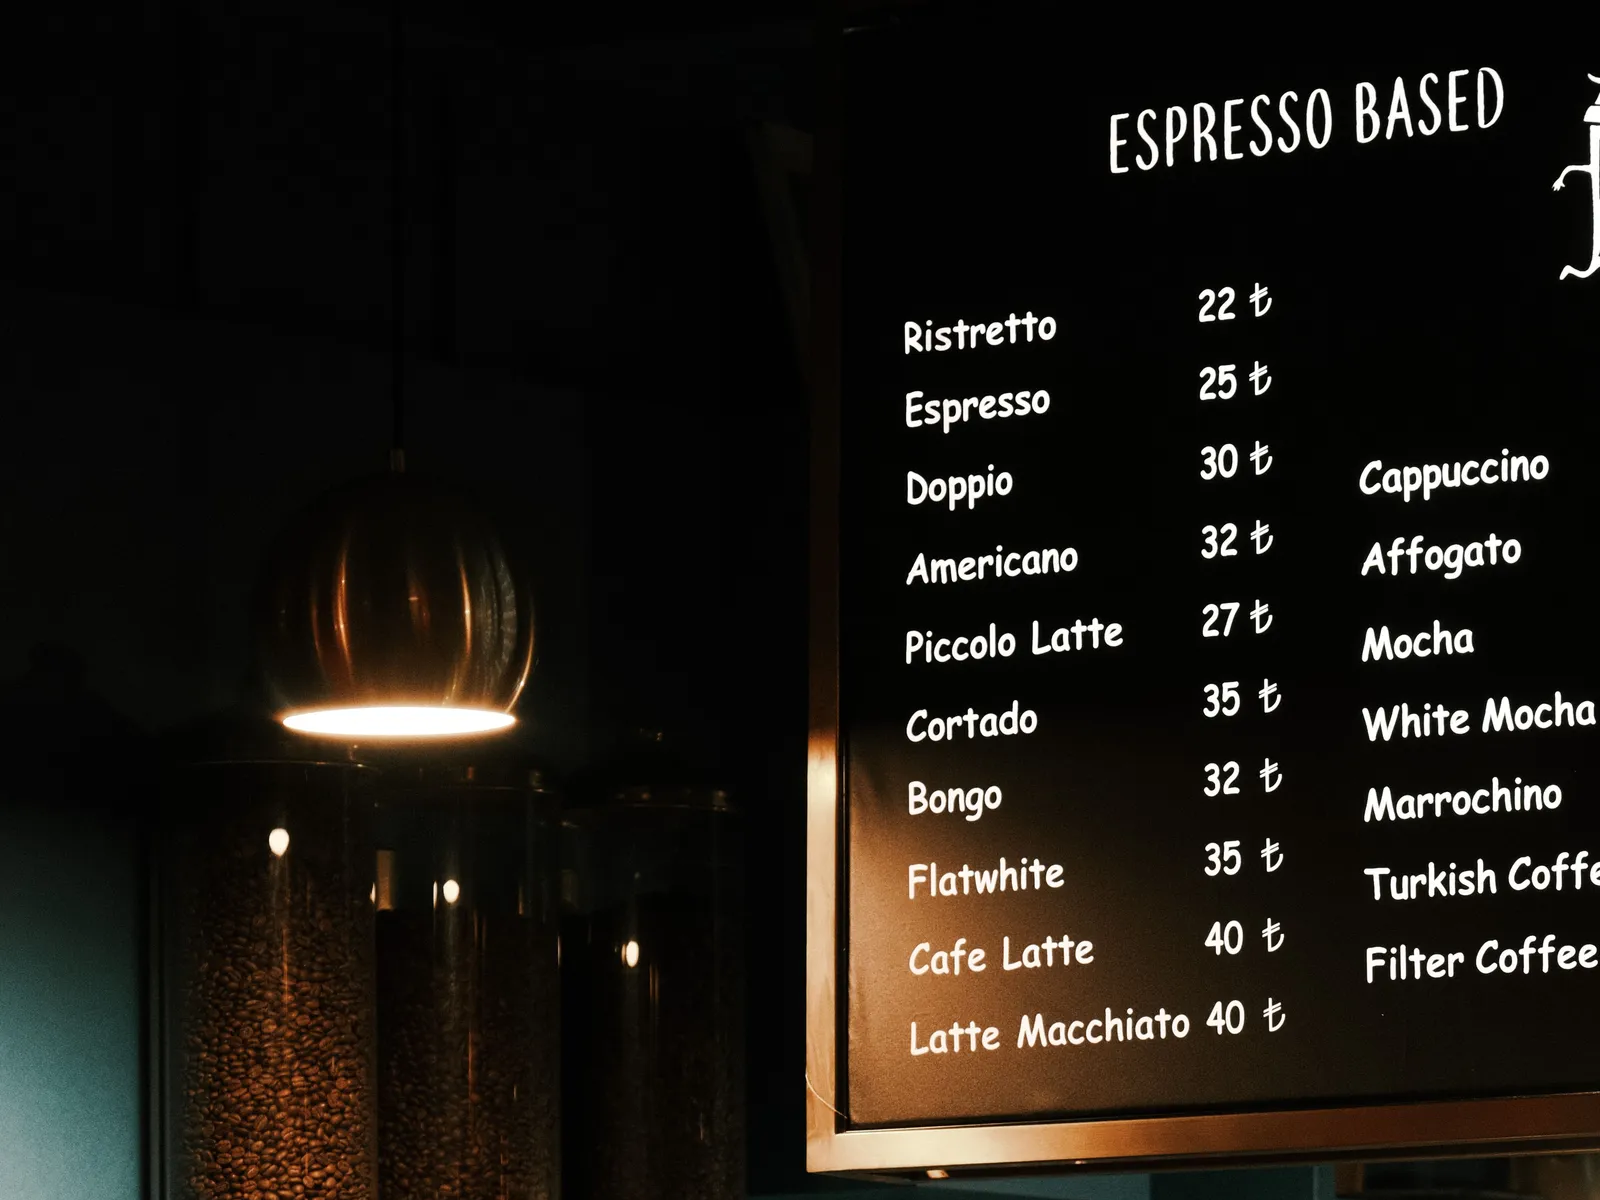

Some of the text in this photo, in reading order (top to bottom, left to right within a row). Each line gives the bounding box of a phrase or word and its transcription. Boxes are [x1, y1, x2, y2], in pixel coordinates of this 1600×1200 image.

[1110, 66, 1505, 174] ESPRESSO BASED
[1198, 286, 1236, 323] 22
[904, 310, 1057, 355] Ristretto
[1199, 363, 1238, 401] 25
[905, 389, 1051, 435] Espresso
[1199, 443, 1239, 481] 30
[1358, 448, 1550, 503] Cappuccino
[906, 463, 1013, 512] Doppio
[1200, 522, 1238, 560] 32
[1360, 532, 1522, 580] Affogato
[905, 544, 1079, 586] Americano
[905, 617, 1124, 665] Piccolo Latte
[1202, 602, 1240, 638] 27
[1361, 619, 1475, 663] Mocha
[1202, 680, 1241, 718] 35
[1361, 690, 1597, 742] White Mocha
[906, 699, 1038, 743] Cortado
[1203, 760, 1241, 798] 32
[1363, 776, 1563, 823] Marrochino
[908, 780, 1003, 822] Bongo
[908, 856, 1065, 900] Flatwhite
[1204, 839, 1242, 877] 35
[1363, 858, 1498, 901] Turkish
[908, 934, 1095, 976] Cafe Latte
[1204, 919, 1244, 956] 40
[1366, 933, 1599, 984] Filter Coffee
[909, 1007, 1190, 1057] Latte Macchiato
[1205, 999, 1245, 1036] 40
